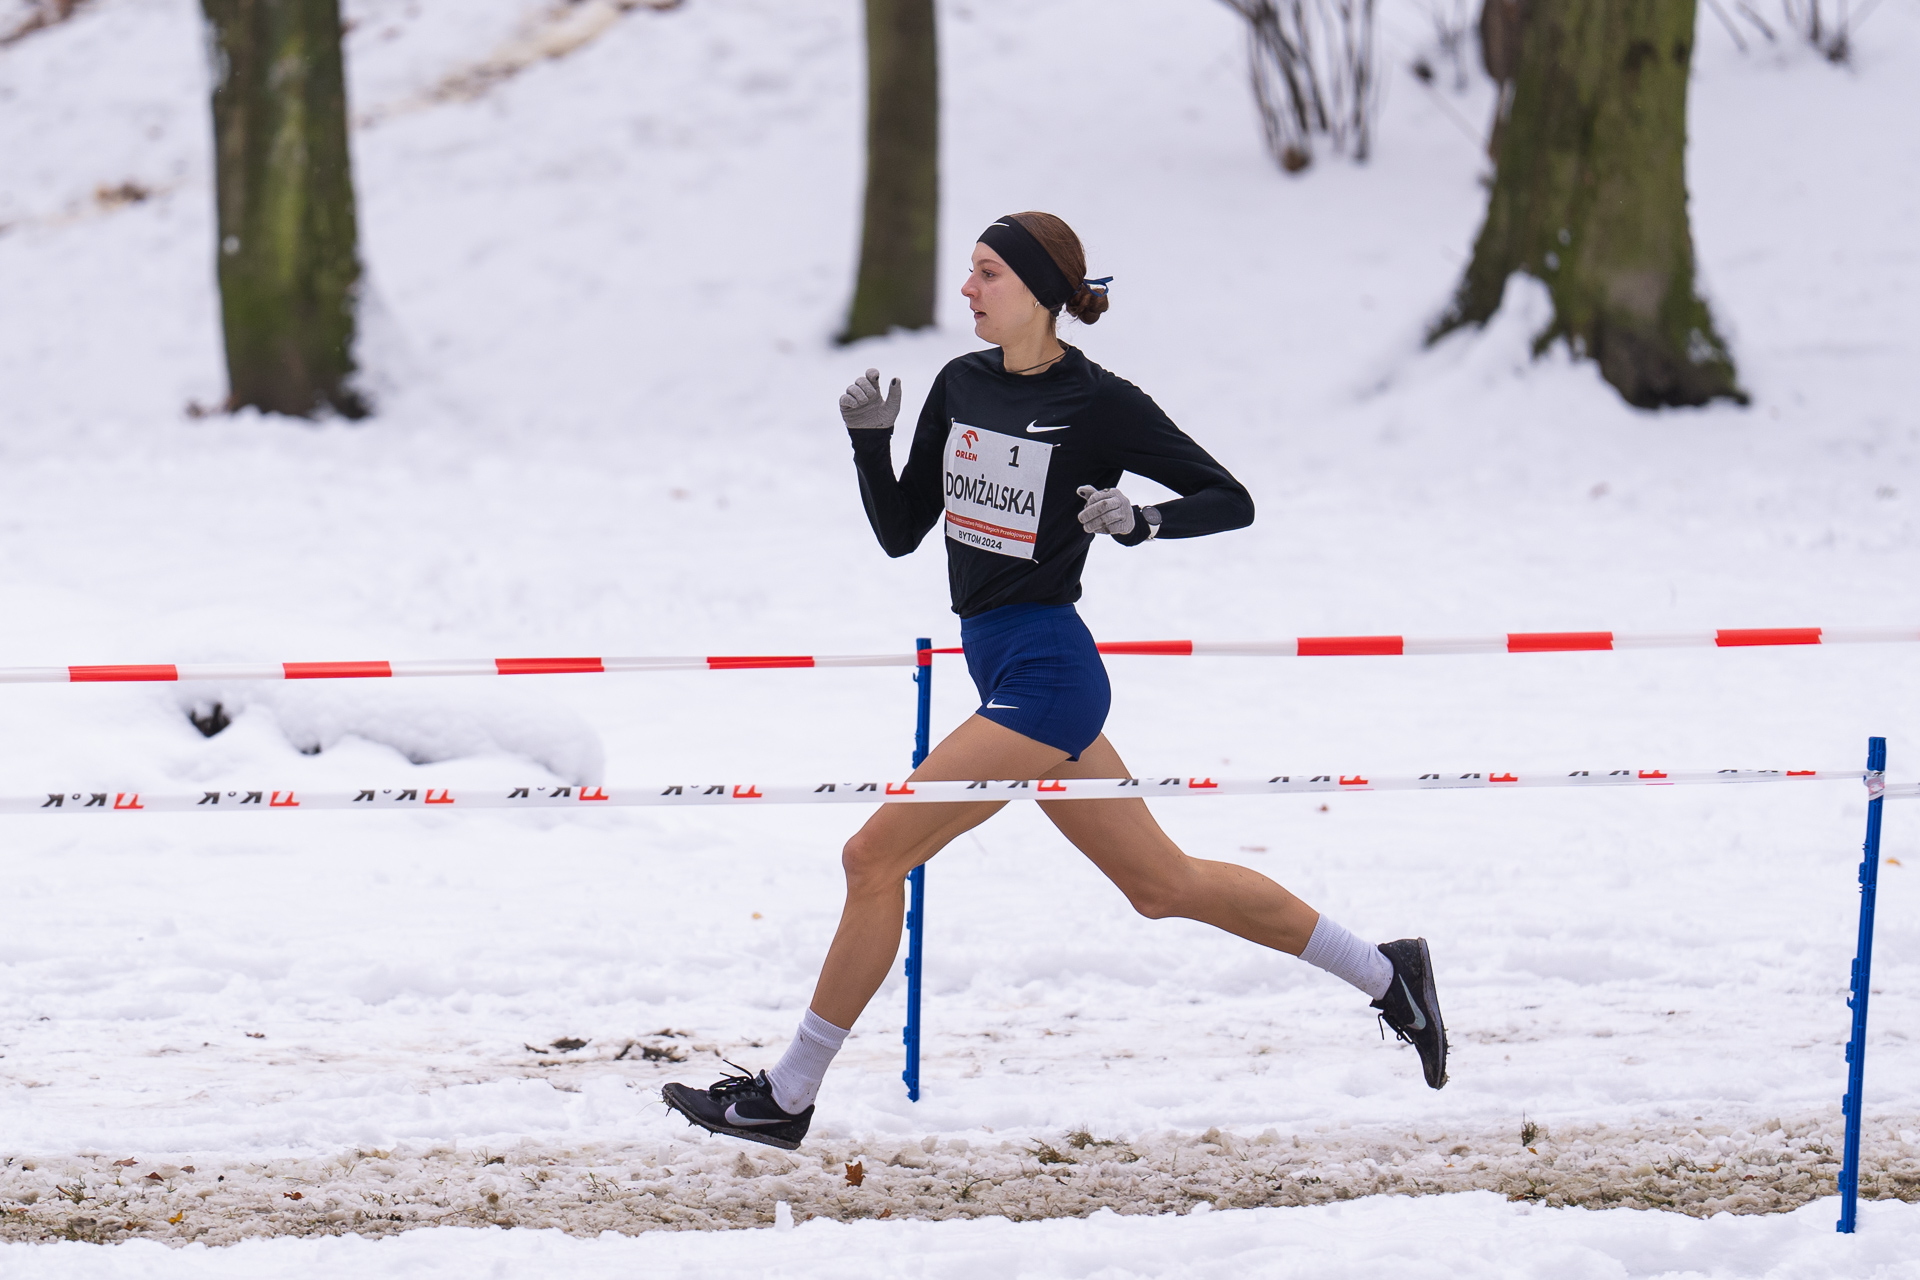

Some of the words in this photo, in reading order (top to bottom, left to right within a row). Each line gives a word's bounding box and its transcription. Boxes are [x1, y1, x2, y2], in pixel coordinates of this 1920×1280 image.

[955, 449, 978, 462] ORLEN
[1008, 445, 1020, 468] 1
[946, 471, 1036, 517] DOMŻALSKA
[958, 530, 982, 545] BYTOM
[981, 537, 1002, 550] 2024
